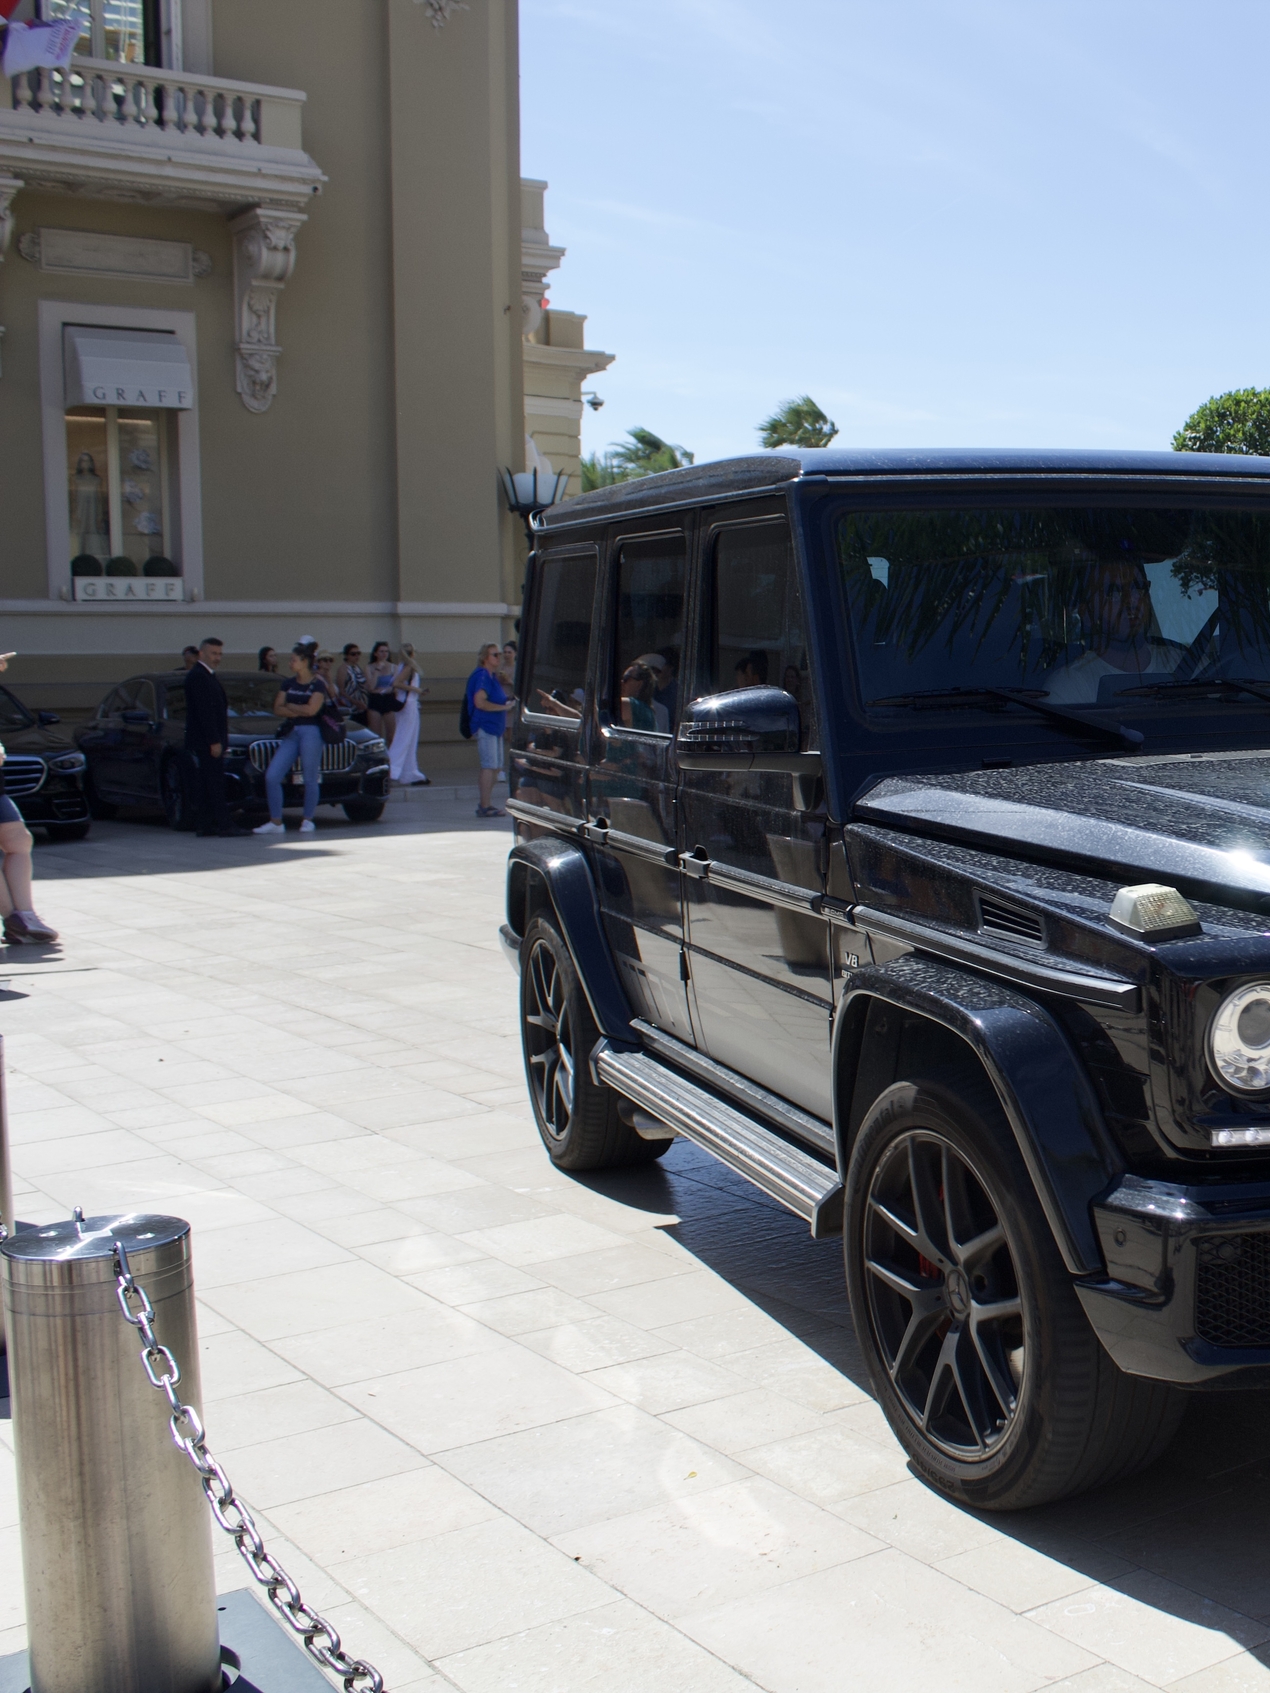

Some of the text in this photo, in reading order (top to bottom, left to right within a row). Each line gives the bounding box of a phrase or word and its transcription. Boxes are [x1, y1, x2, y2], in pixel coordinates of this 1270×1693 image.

[92, 386, 188, 404] GRAFF
[82, 582, 176, 597] GRAFF
[844, 952, 859, 968] V8
